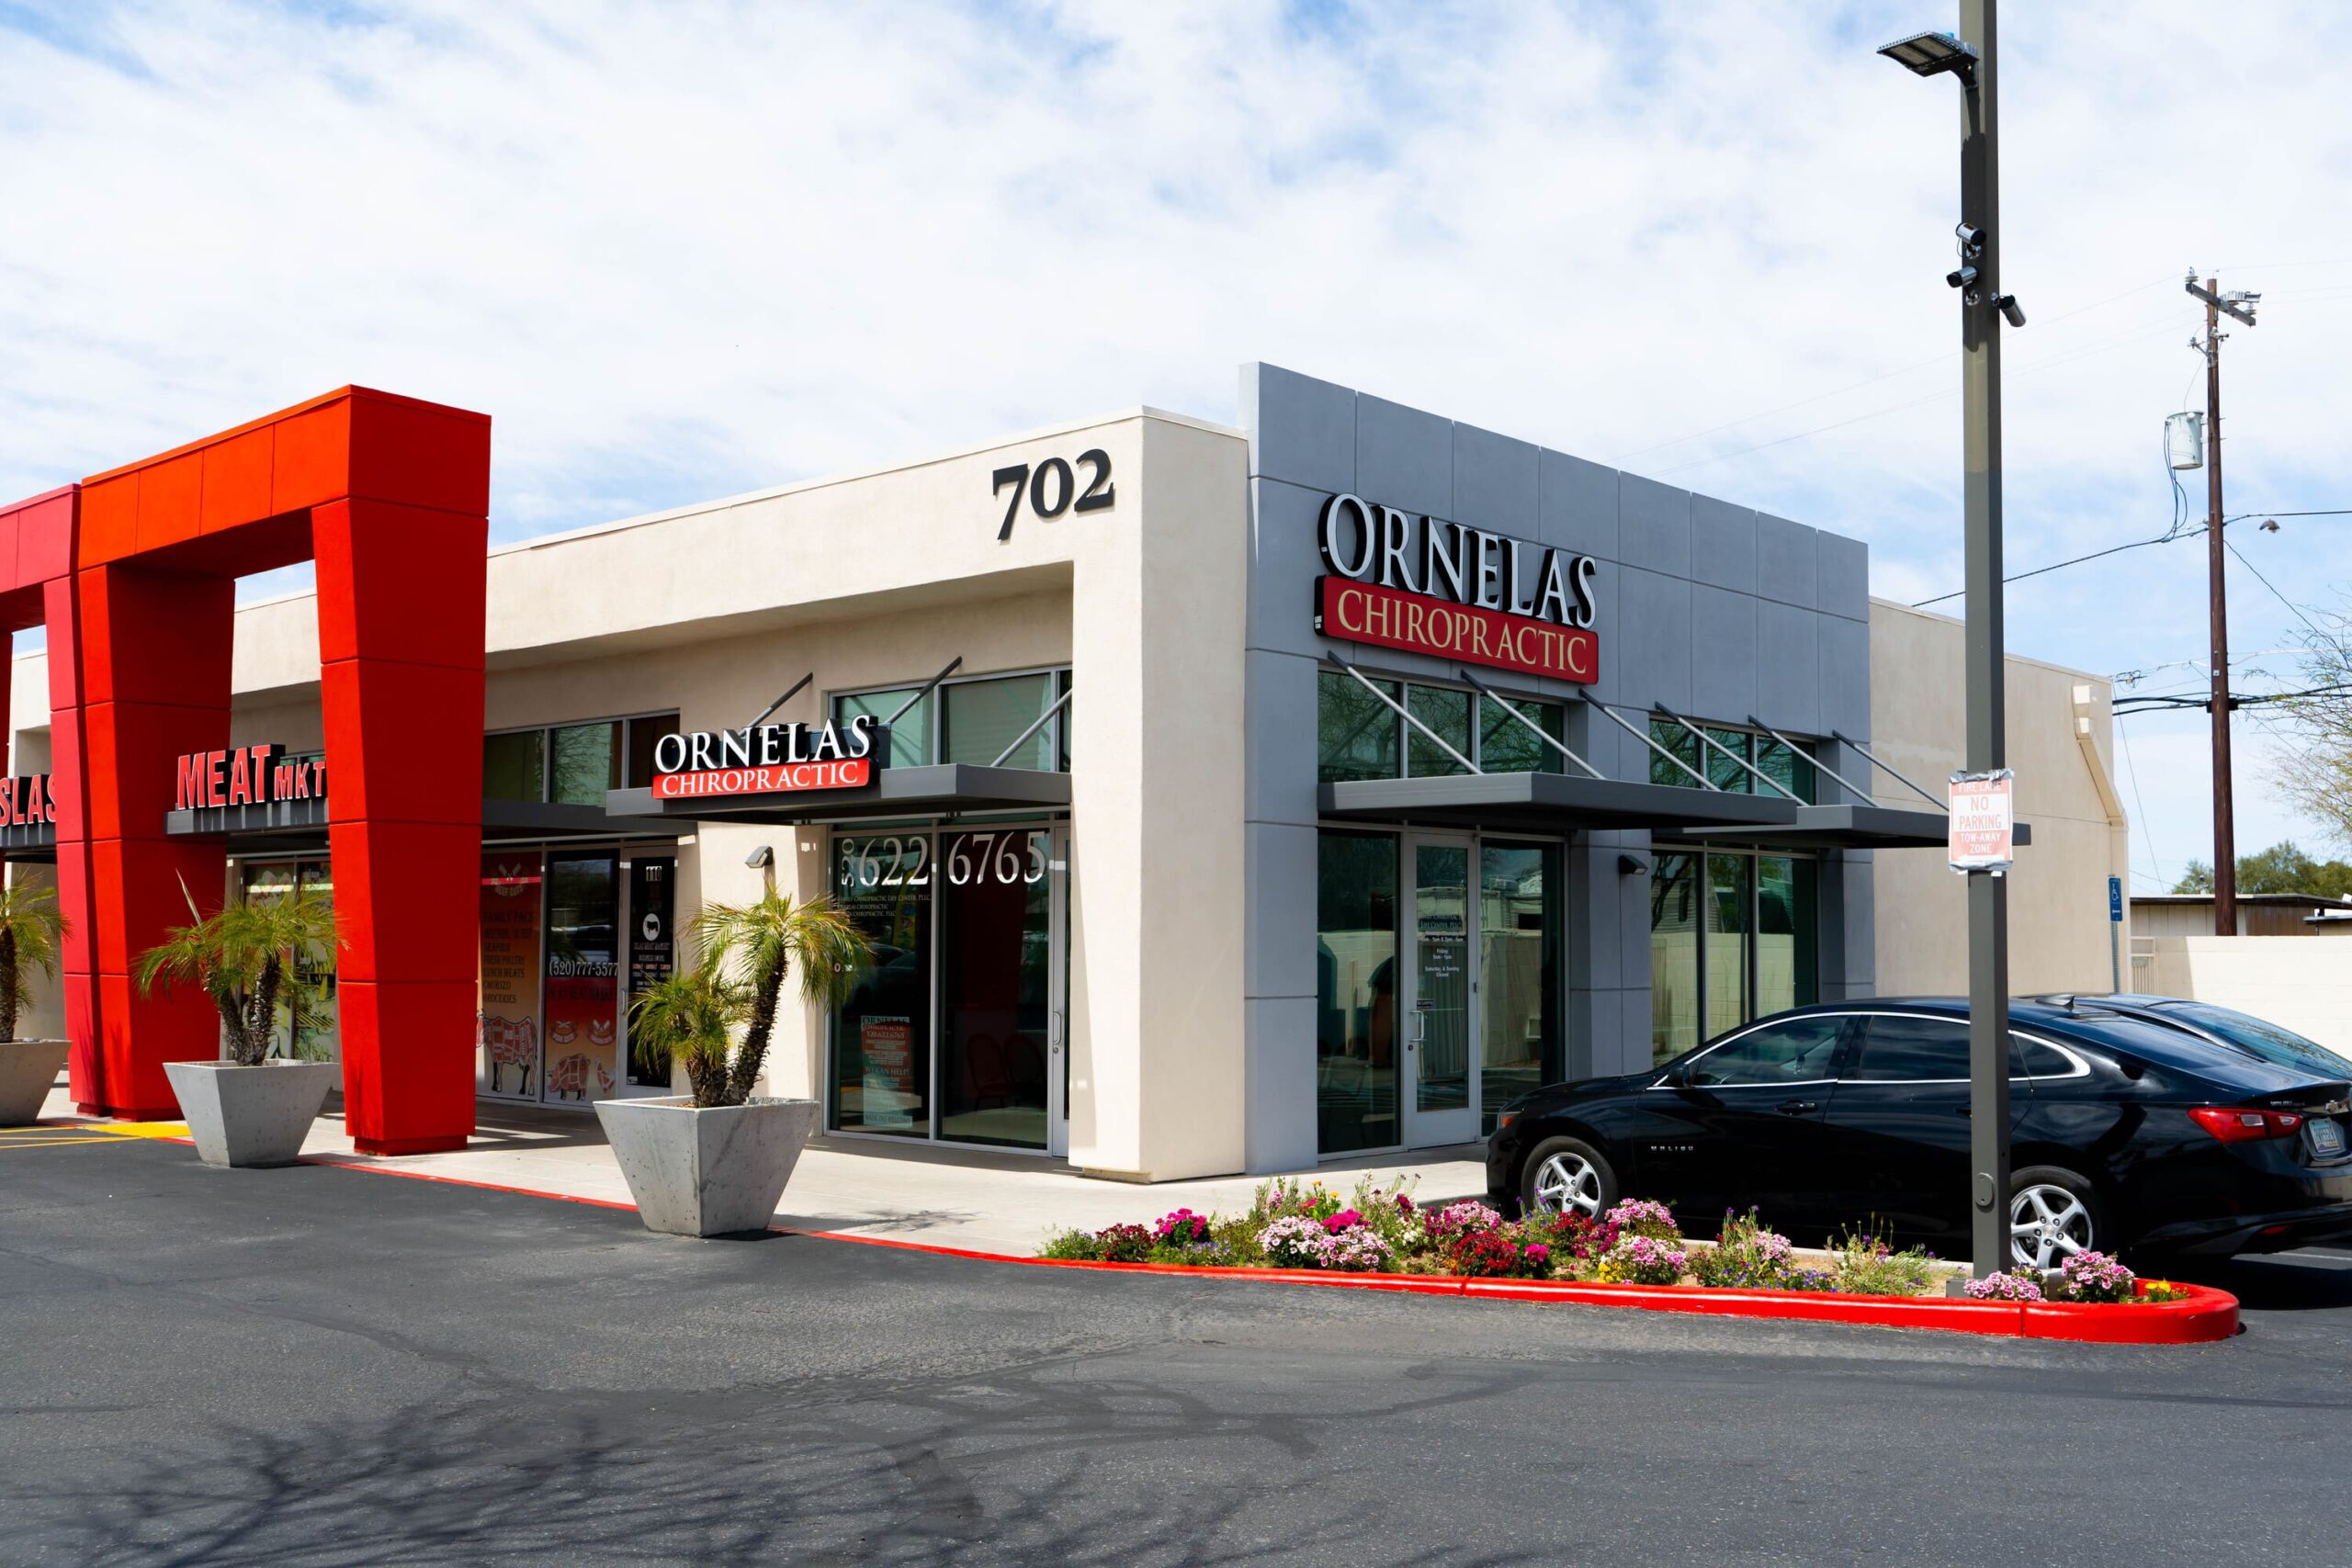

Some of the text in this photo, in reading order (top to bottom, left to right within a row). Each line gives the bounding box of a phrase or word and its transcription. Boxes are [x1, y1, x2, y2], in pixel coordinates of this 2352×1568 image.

[992, 448, 1114, 541] 702
[1324, 492, 1597, 629] ORNELAS
[1337, 588, 1587, 674] CHIROPRACTIC
[655, 714, 872, 773] ORNELAS
[177, 743, 326, 811] MEAT MKT
[662, 761, 860, 795] CHIROPRACTIC
[1958, 781, 1980, 793] FIRE
[1970, 795, 1989, 811] NO
[1959, 814, 2003, 830] PARKING
[1960, 831, 2001, 843] TOW-AWAY
[1969, 843, 1993, 854] ZONE
[859, 836, 929, 887] 622
[947, 831, 1046, 885] 6765
[647, 866, 662, 881] 110
[1650, 1145, 1694, 1153] MALIBU
